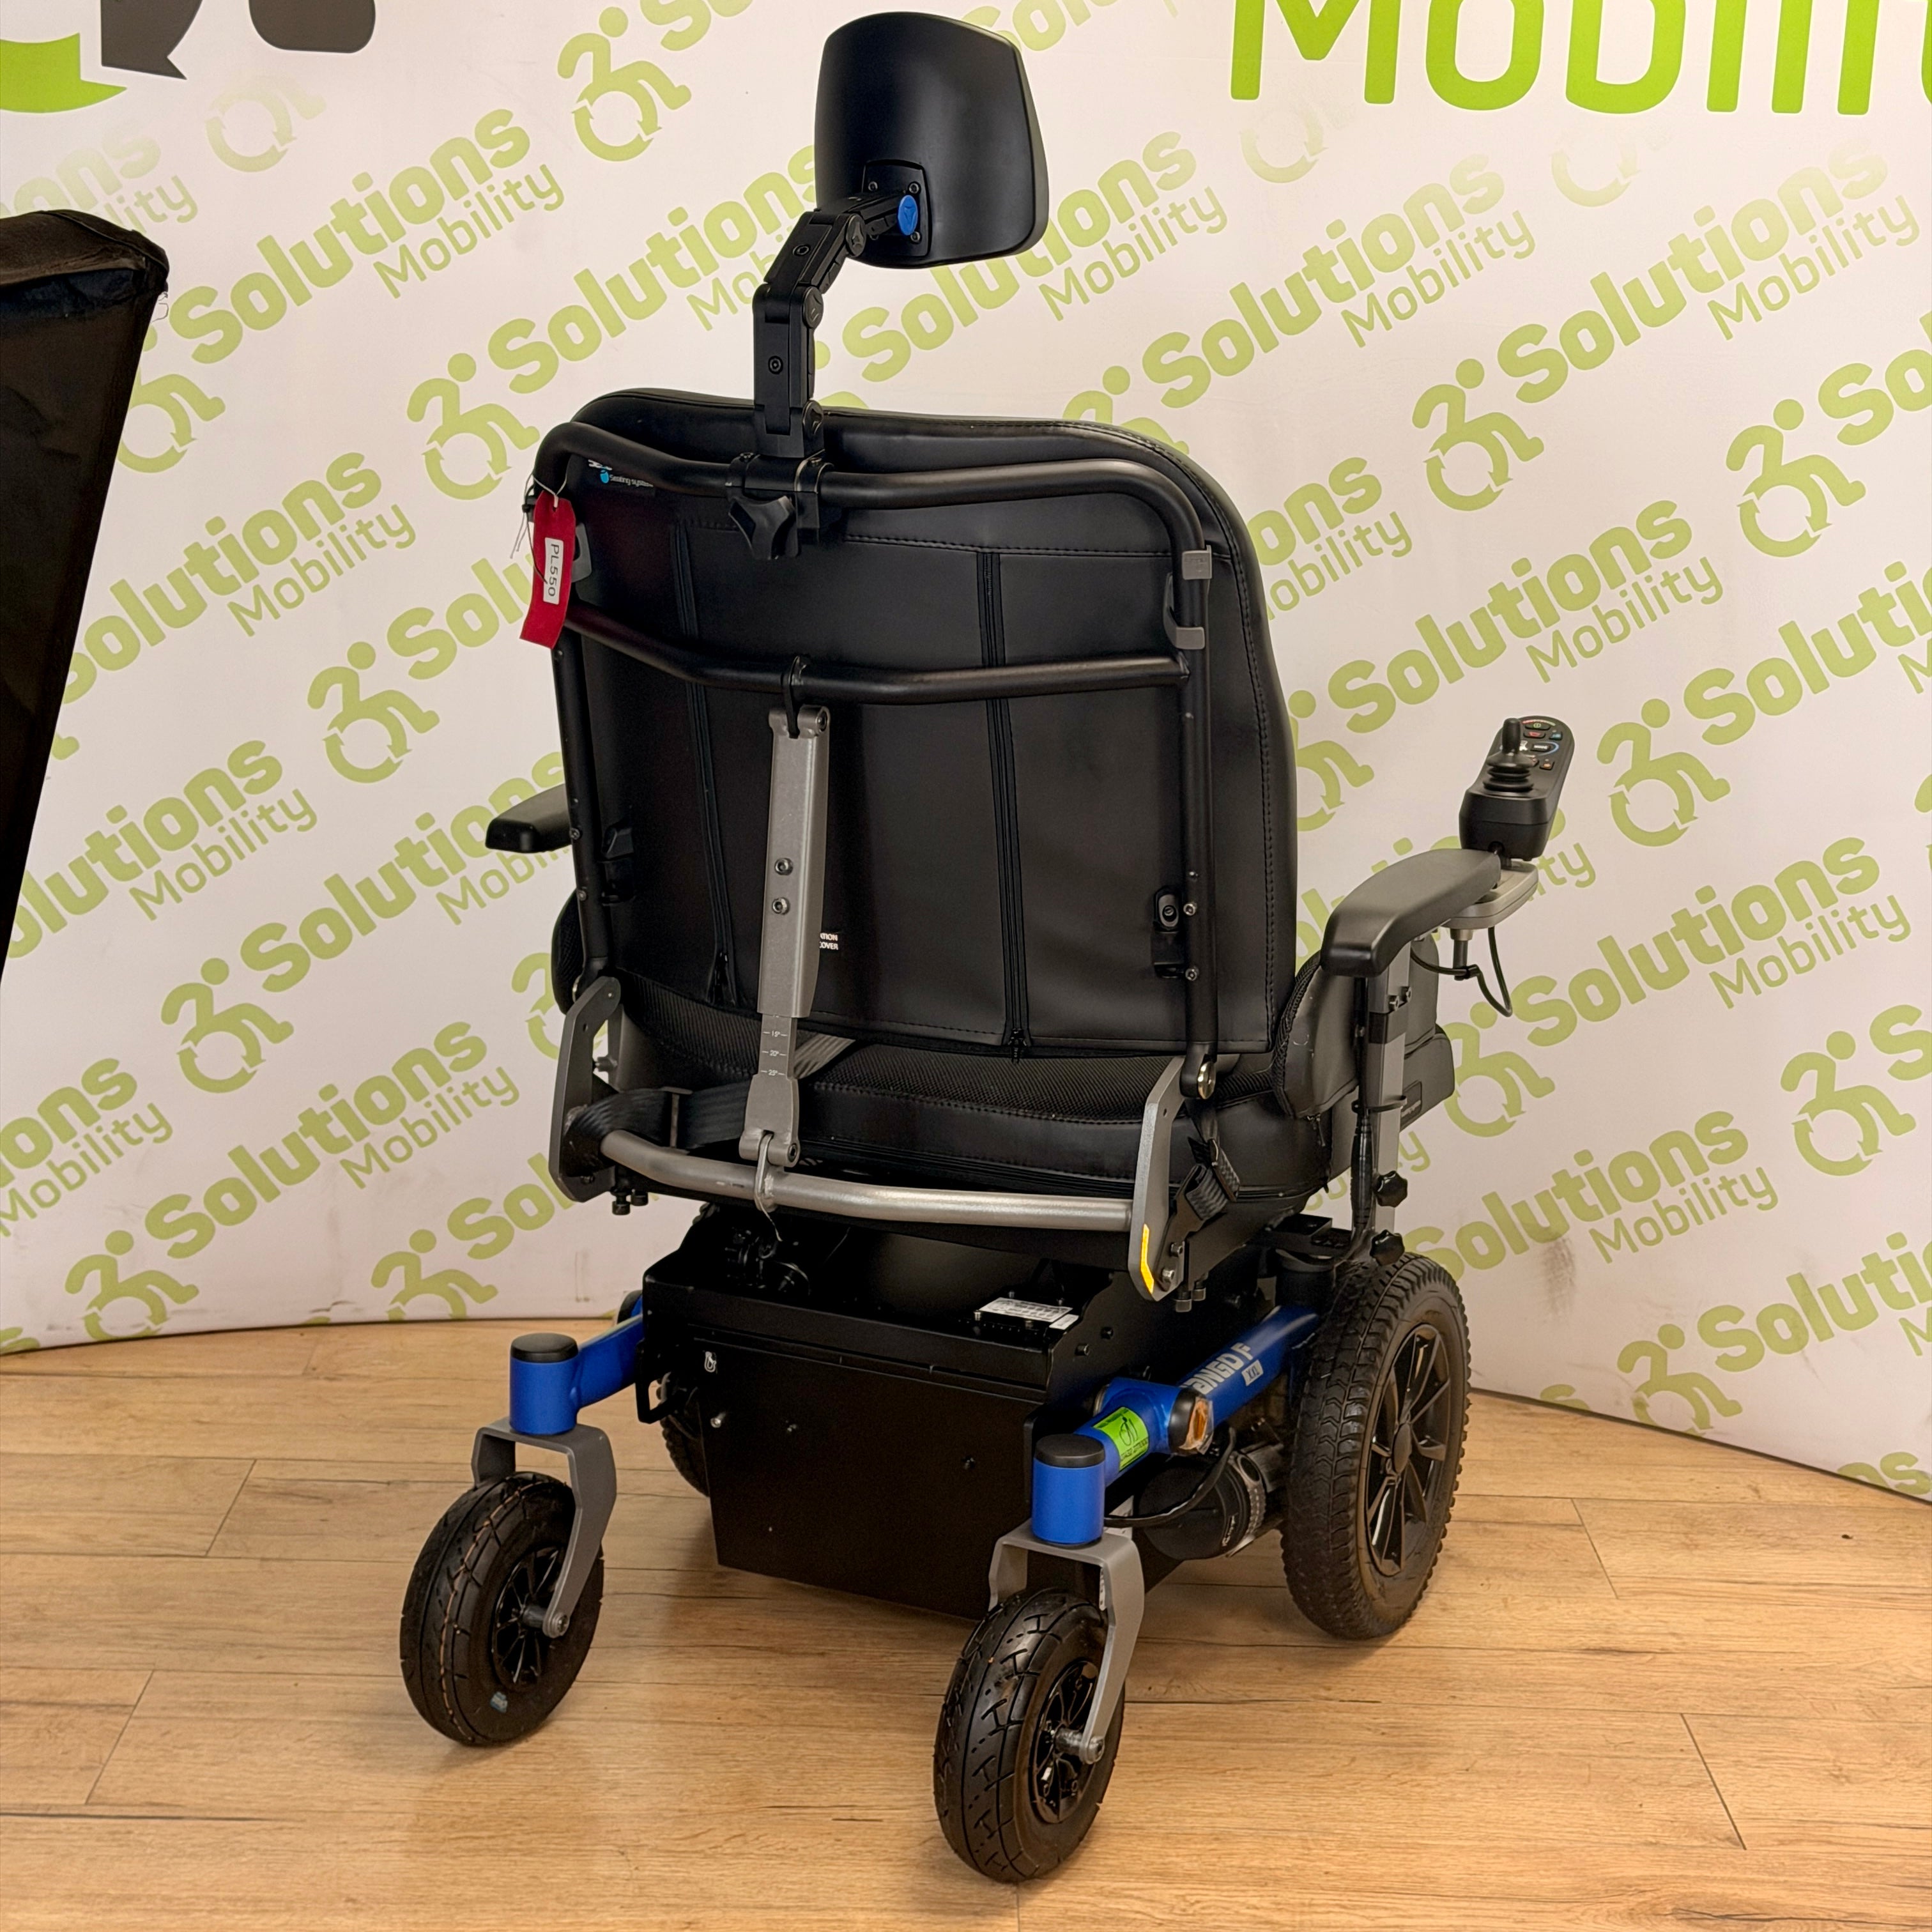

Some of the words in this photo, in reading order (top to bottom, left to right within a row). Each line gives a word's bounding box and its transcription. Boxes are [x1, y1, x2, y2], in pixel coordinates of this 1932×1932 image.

[1230, 0, 1932, 115] Mobili
[169, 109, 530, 364] Solutions
[373, 164, 565, 299] Mobility
[1039, 186, 1227, 321] Mobility
[1142, 153, 1505, 408] Solutions
[1342, 210, 1536, 348] Mobility
[1498, 137, 1888, 403] Solutions
[1708, 195, 1920, 341] Mobility
[227, 503, 416, 637] Mobility
[548, 544, 560, 597] PL550
[1328, 500, 1692, 733] Solutions
[1526, 556, 1723, 683] Mobility
[1684, 561, 1932, 746] Soluti
[128, 788, 318, 921] Mobility
[1510, 838, 1880, 1047] Solutions
[1709, 894, 1912, 1009] Mobility
[0, 1103, 173, 1238] Mobility
[145, 1022, 487, 1259] Solutions
[340, 1066, 520, 1190] Mobility
[1403, 1110, 1749, 1282] Solutions
[1589, 1167, 1778, 1264] Mobility
[1698, 1232, 1932, 1372] Soluti
